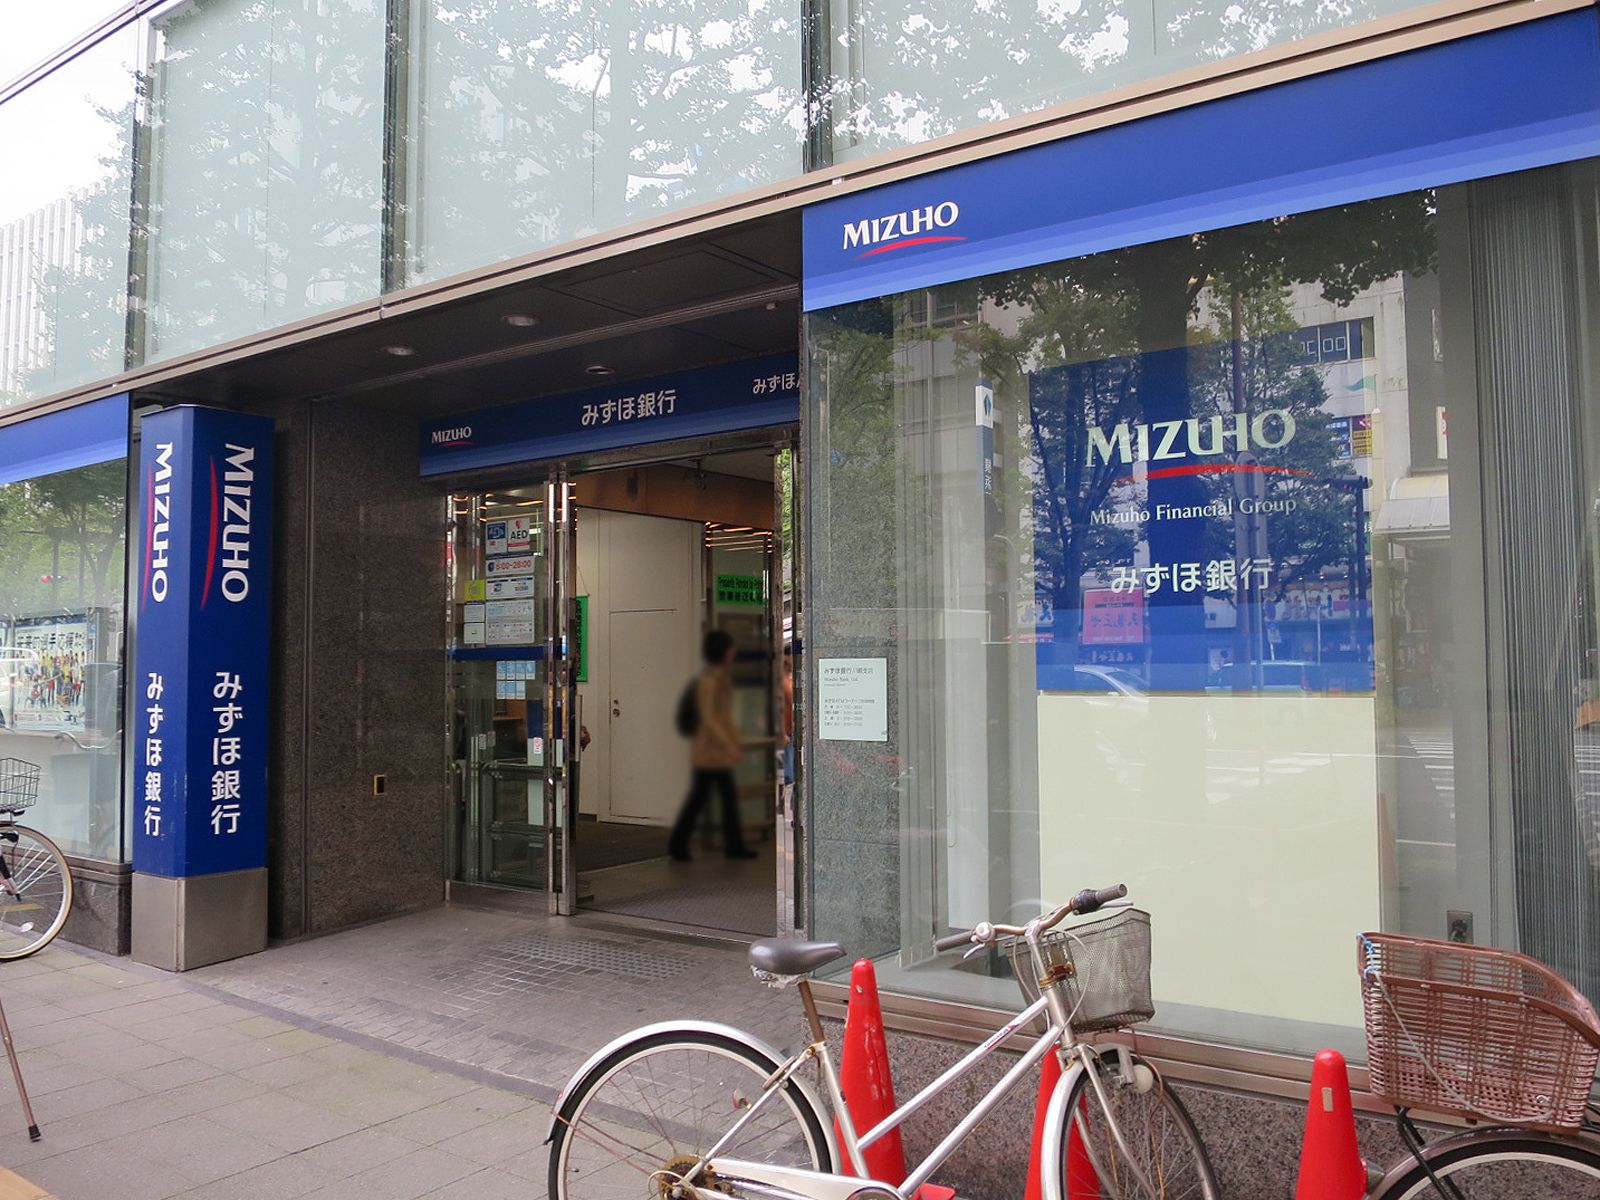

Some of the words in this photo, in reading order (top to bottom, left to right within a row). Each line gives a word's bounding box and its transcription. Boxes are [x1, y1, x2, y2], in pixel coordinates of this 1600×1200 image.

[843, 201, 959, 250] MIZUHO
[752, 372, 800, 394] みずほ
[581, 389, 677, 426] みずほ銀行
[431, 426, 472, 443] MIZUHO
[1085, 409, 1296, 467] MIZUHO
[151, 441, 174, 603] MIZUHO
[221, 443, 254, 603] MIZUHO
[1090, 508, 1150, 525] Mizuho
[1156, 499, 1232, 520] Financial
[1240, 497, 1296, 514] Group
[510, 530, 528, 540] AED
[1110, 558, 1273, 593] みずほ銀行
[144, 672, 164, 837] みずほ銀行
[211, 671, 243, 835] みずほ銀行
